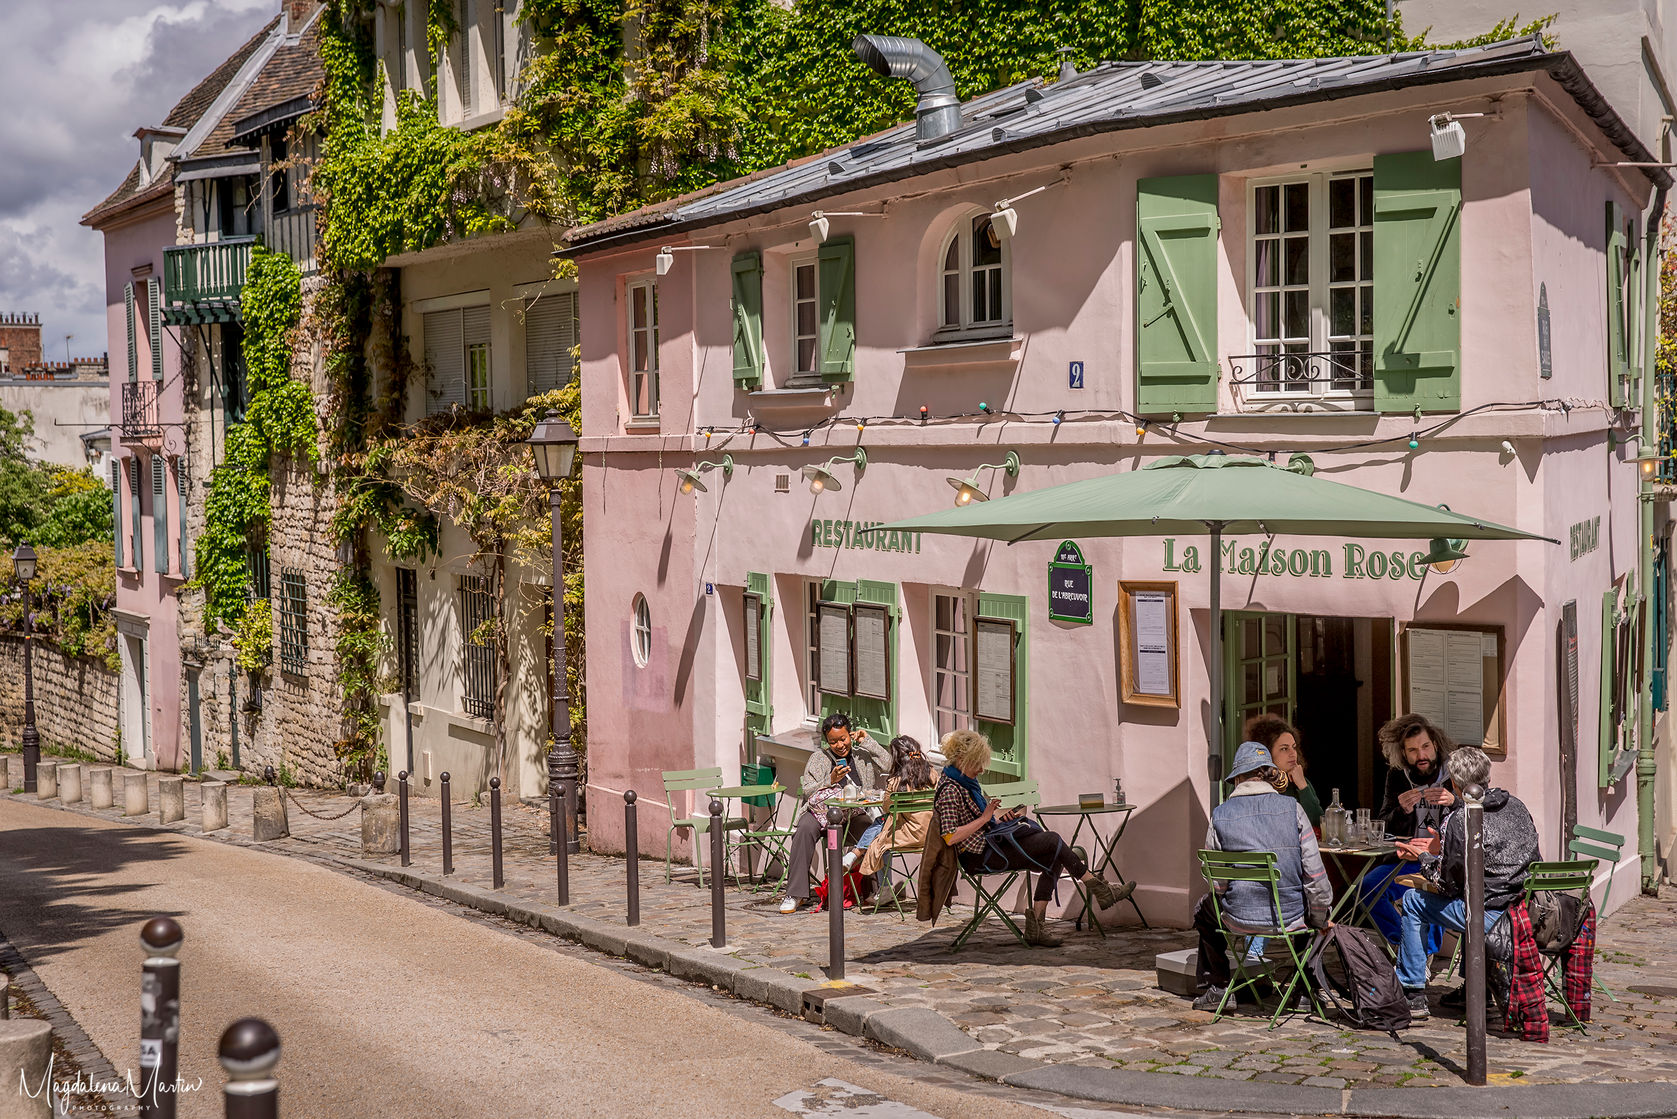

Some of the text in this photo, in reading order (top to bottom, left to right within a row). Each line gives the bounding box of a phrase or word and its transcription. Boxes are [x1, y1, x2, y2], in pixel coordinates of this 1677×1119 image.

[1072, 363, 1080, 387] 2
[812, 519, 921, 554] RESTAURANT
[1570, 515, 1600, 562] RESTAURANT
[1163, 538, 1427, 580] La Maison Rose
[1052, 590, 1058, 599] DE
[1064, 580, 1074, 589] RUE
